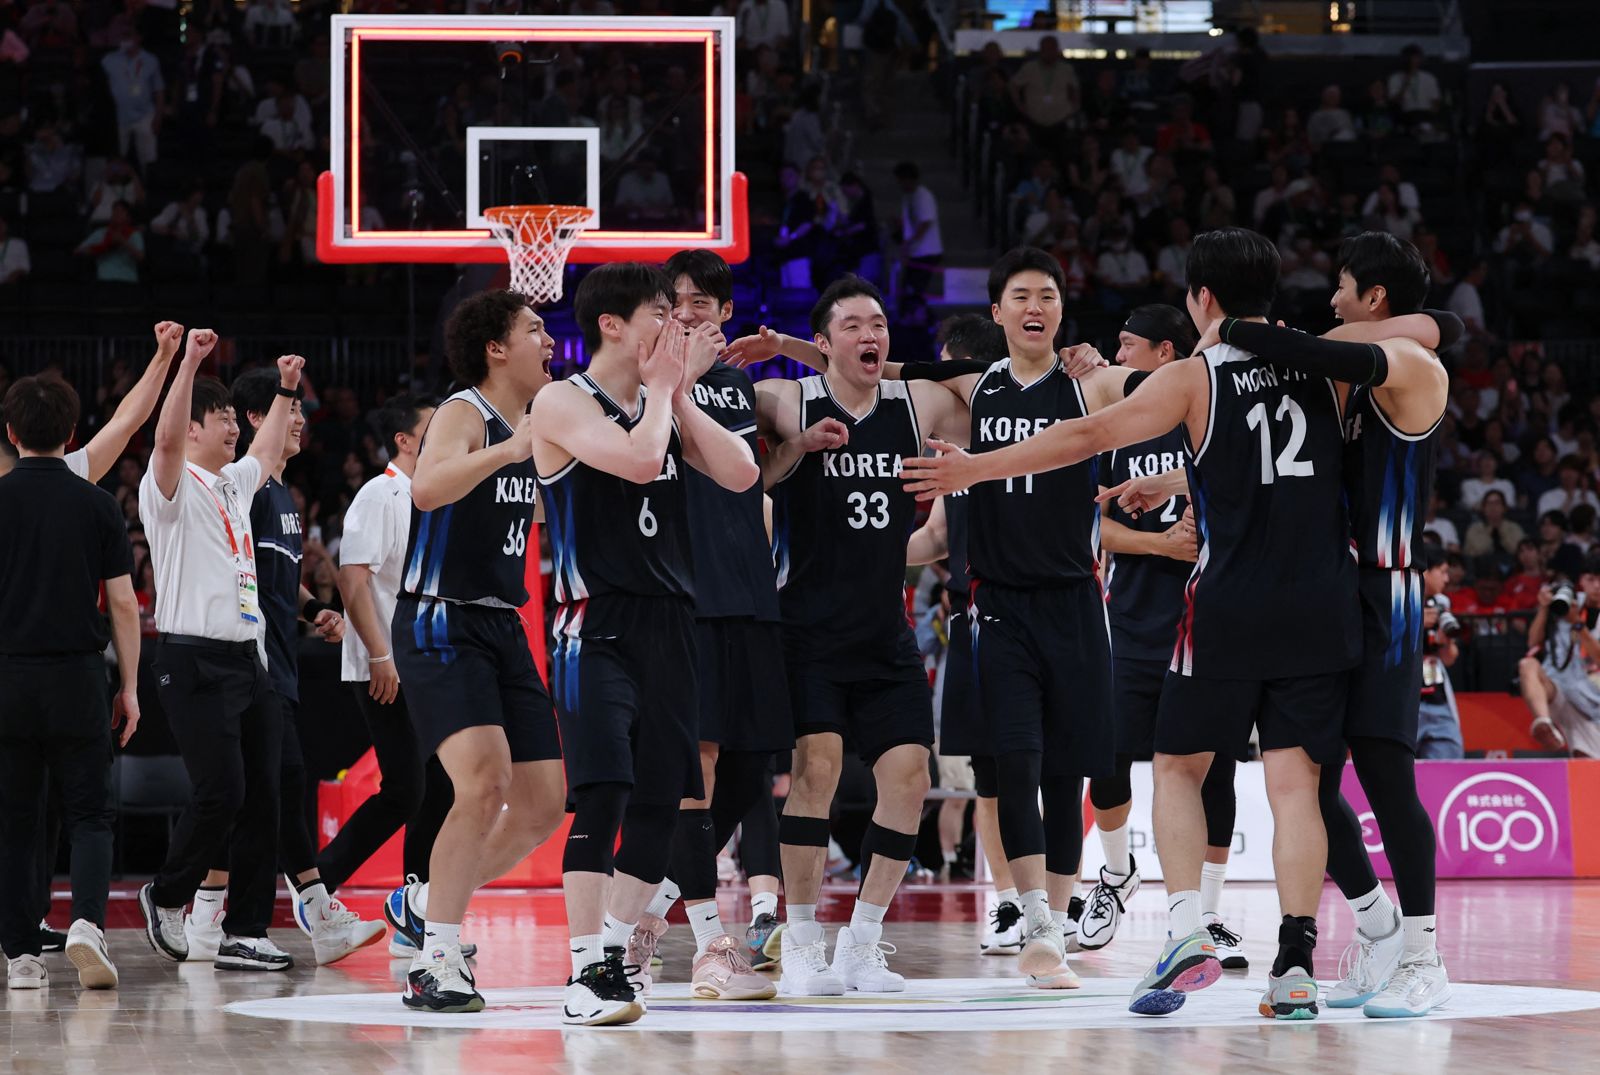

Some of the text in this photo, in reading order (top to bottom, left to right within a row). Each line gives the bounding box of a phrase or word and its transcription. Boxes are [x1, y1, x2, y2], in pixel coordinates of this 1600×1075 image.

[979, 416, 1063, 443] KORE
[1246, 394, 1315, 485] 12
[822, 452, 904, 478] KOREA
[638, 496, 659, 538] 6
[846, 491, 890, 530] 33
[1456, 809, 1545, 853] 100
